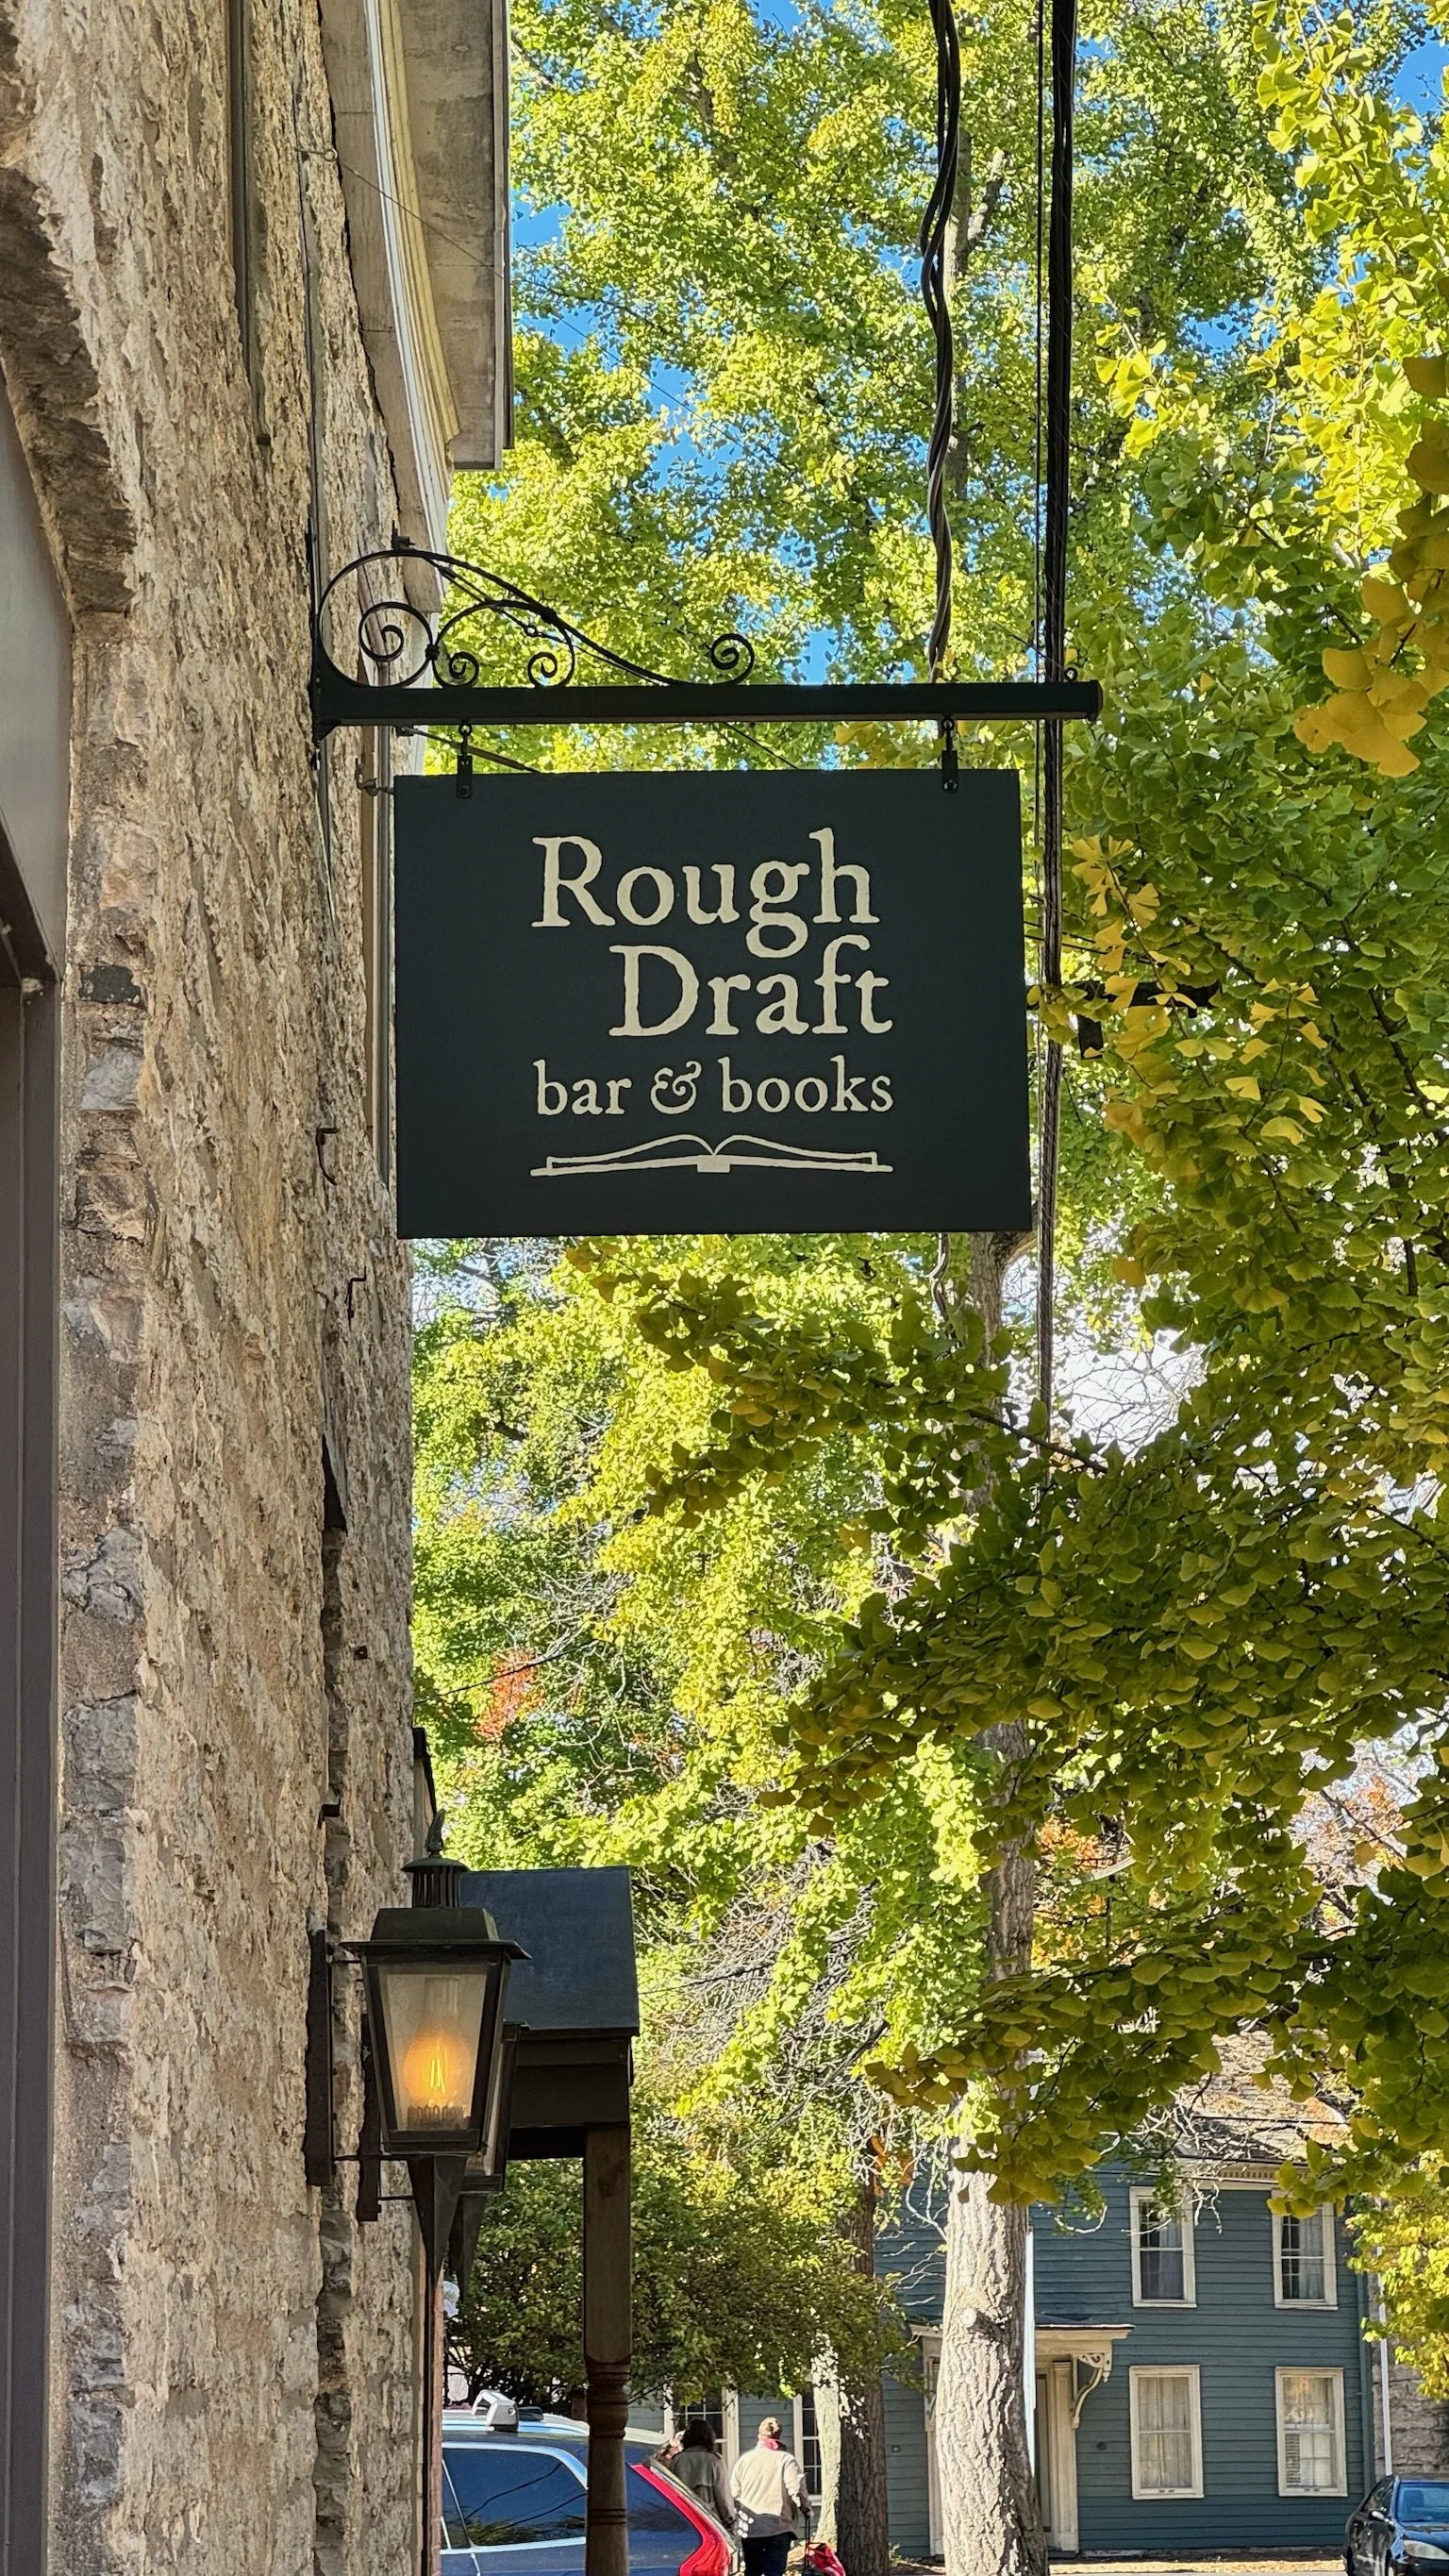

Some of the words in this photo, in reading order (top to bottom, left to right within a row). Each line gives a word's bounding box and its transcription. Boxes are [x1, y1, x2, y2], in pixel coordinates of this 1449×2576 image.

[531, 828, 880, 959] Rough
[608, 934, 893, 1037] Draft
[532, 1059, 632, 1116] bar
[650, 1061, 702, 1114] &
[717, 1054, 893, 1113] books
